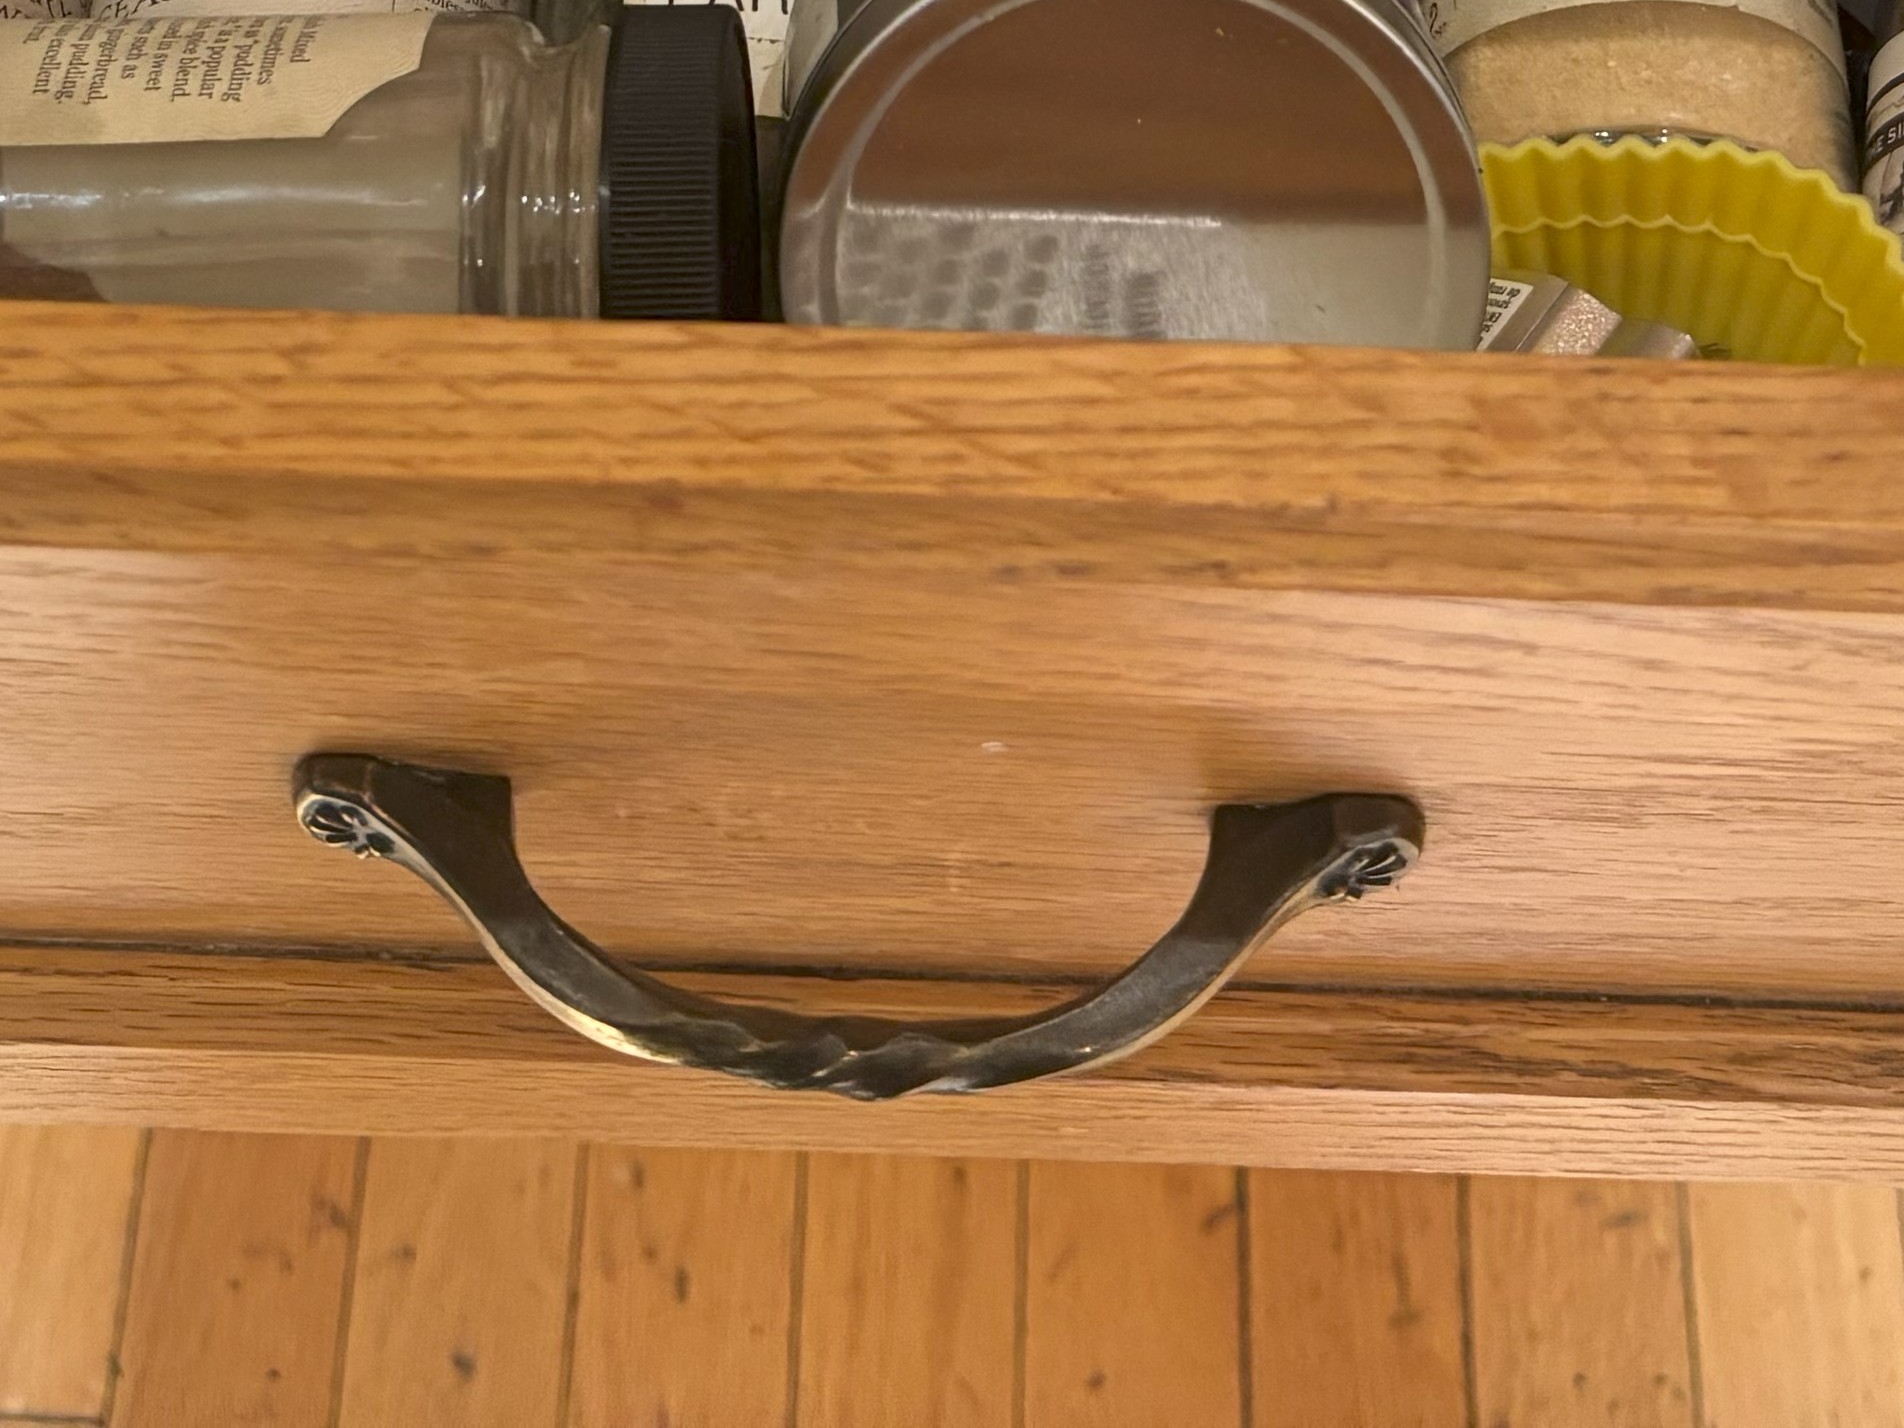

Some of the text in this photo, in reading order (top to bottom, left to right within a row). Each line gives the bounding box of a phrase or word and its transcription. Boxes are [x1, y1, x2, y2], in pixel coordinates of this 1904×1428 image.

[33, 37, 67, 95] excellent
[143, 52, 169, 92] sweet
[198, 43, 228, 100] popular
